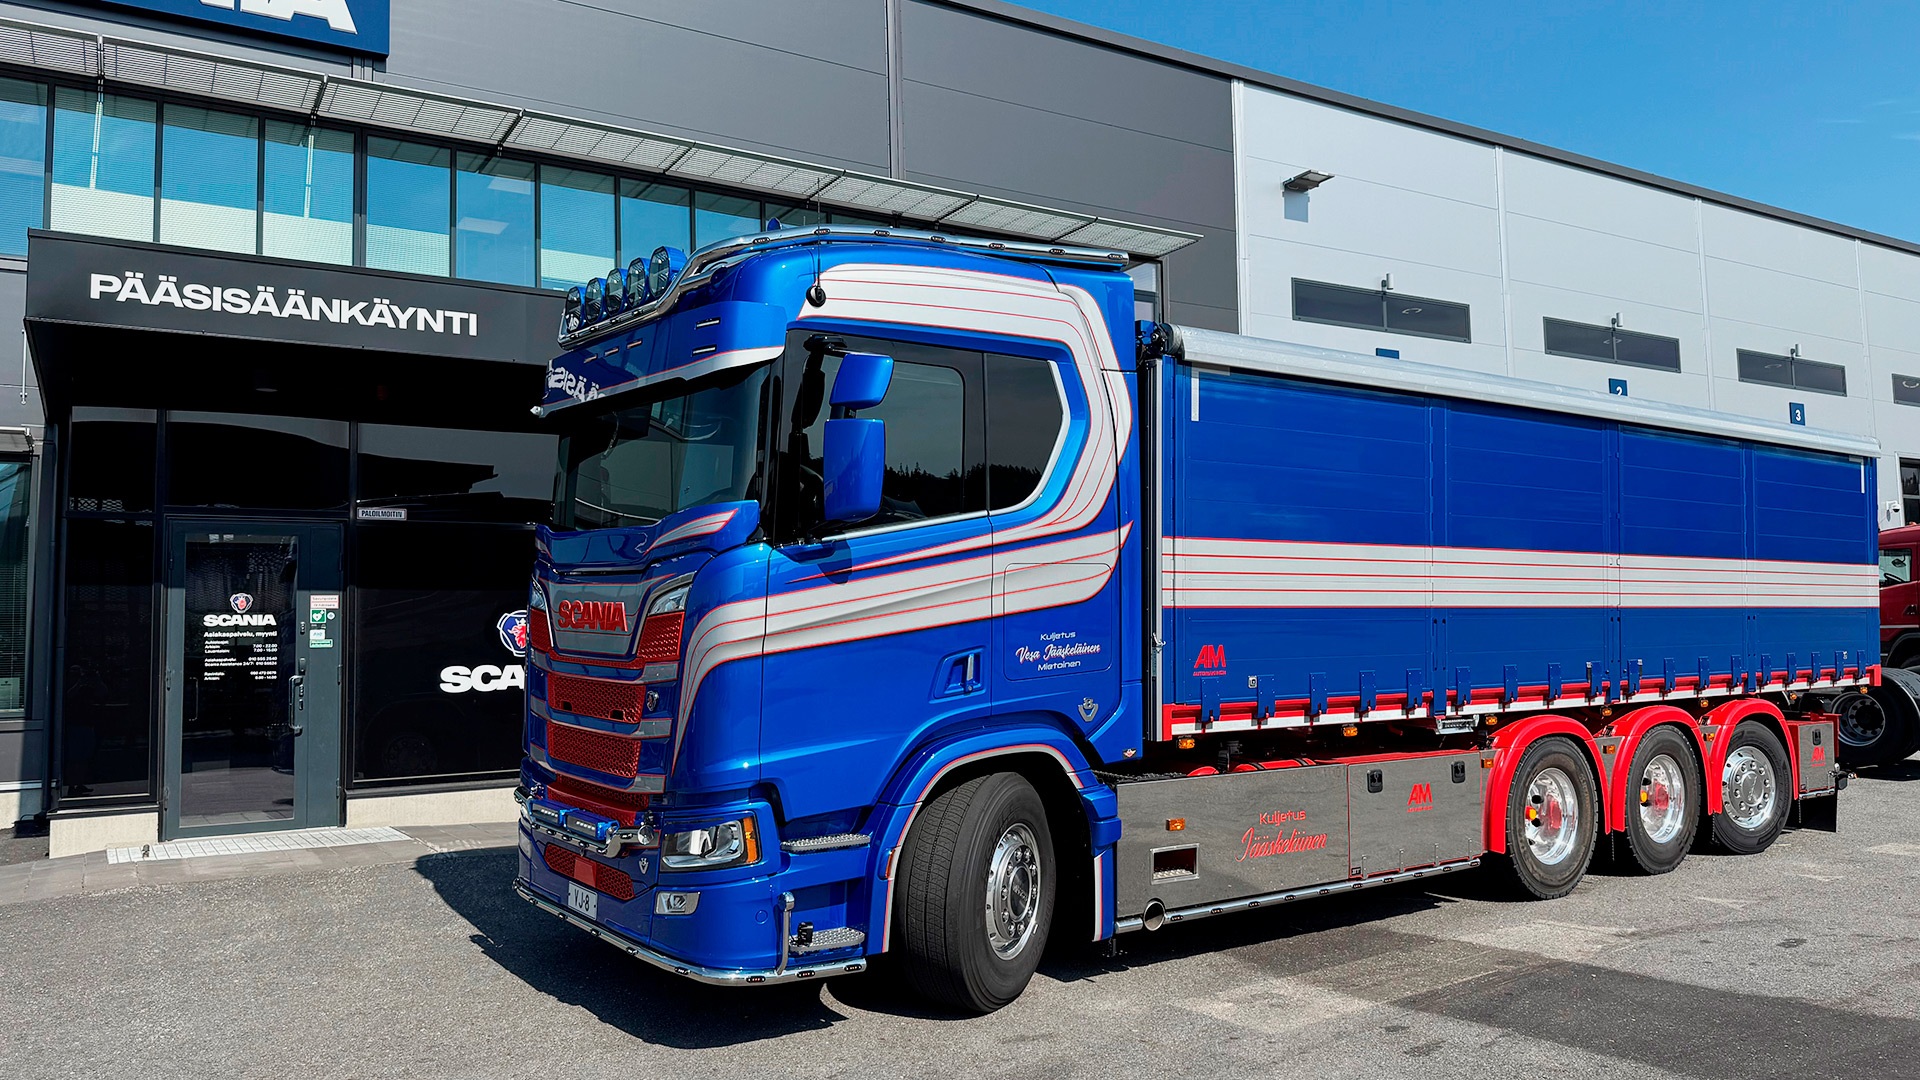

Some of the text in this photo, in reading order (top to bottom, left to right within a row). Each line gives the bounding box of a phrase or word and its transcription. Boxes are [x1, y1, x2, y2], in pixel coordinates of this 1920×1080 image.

[90, 271, 478, 337] PÄÄSISÄÄNKÄYNTI
[1795, 409, 1801, 421] 3
[203, 614, 277, 627] SCANIA
[558, 600, 628, 632] SCANIA
[1040, 632, 1076, 641] Kuljetus
[1042, 643, 1101, 661] Jääskeläinen
[1194, 644, 1227, 669] AM
[1037, 660, 1081, 671] Mietoinen
[1407, 783, 1433, 806] AM
[1260, 810, 1307, 826] Kuljetus
[1235, 827, 1328, 863] Jääskeläinen
